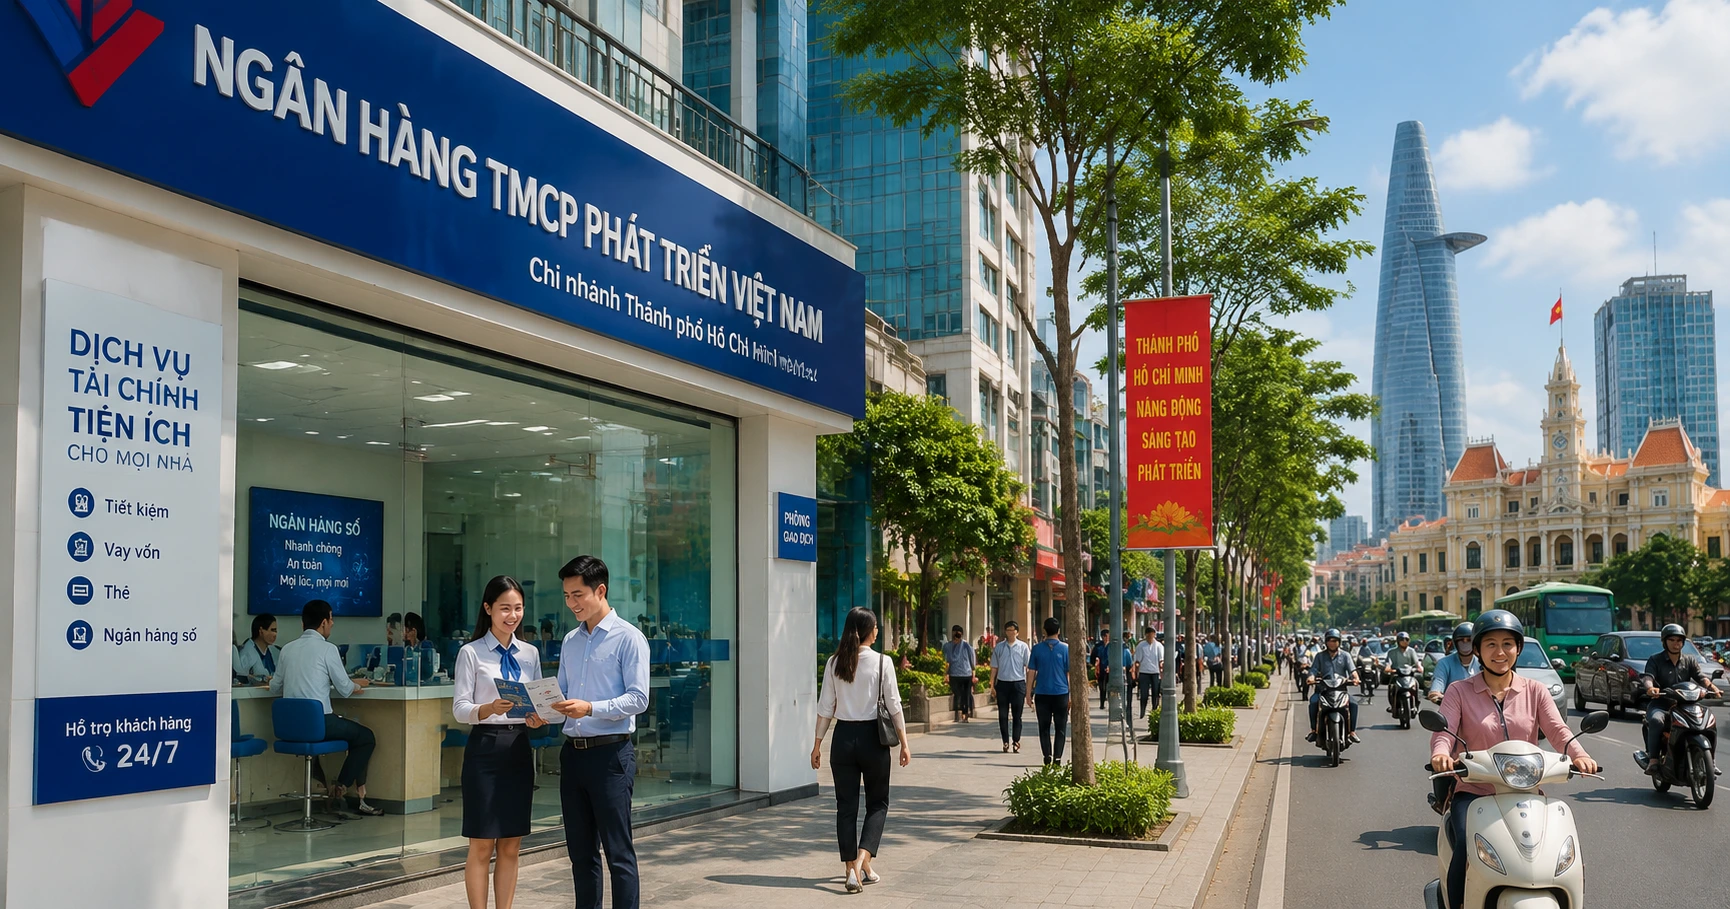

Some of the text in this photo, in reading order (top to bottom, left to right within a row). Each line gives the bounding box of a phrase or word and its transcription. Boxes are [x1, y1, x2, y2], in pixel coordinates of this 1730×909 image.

[194, 24, 347, 145] NGÂN
[359, 100, 477, 198] HÀNG
[485, 157, 578, 238] TMCP
[584, 202, 655, 272] PHÁT
[731, 270, 776, 329] VIỆT
[780, 292, 823, 343] NAM
[529, 257, 561, 290] Chi
[70, 328, 190, 381] DỊCH VỤ
[68, 366, 109, 397] TÀI
[1152, 363, 1171, 386] CHÍ
[1174, 366, 1204, 385] MINH
[67, 404, 190, 447] TIỆN ÍCH
[1142, 427, 1197, 453] SÁNG TẠO
[67, 443, 108, 463] CHO
[116, 450, 150, 471] MỌI
[1138, 459, 1167, 482] PHÁT
[104, 542, 131, 562] Vay
[284, 539, 313, 552] Nhanh
[286, 557, 300, 569] An
[104, 628, 141, 645] Ngân
[117, 740, 179, 768] 24/7
